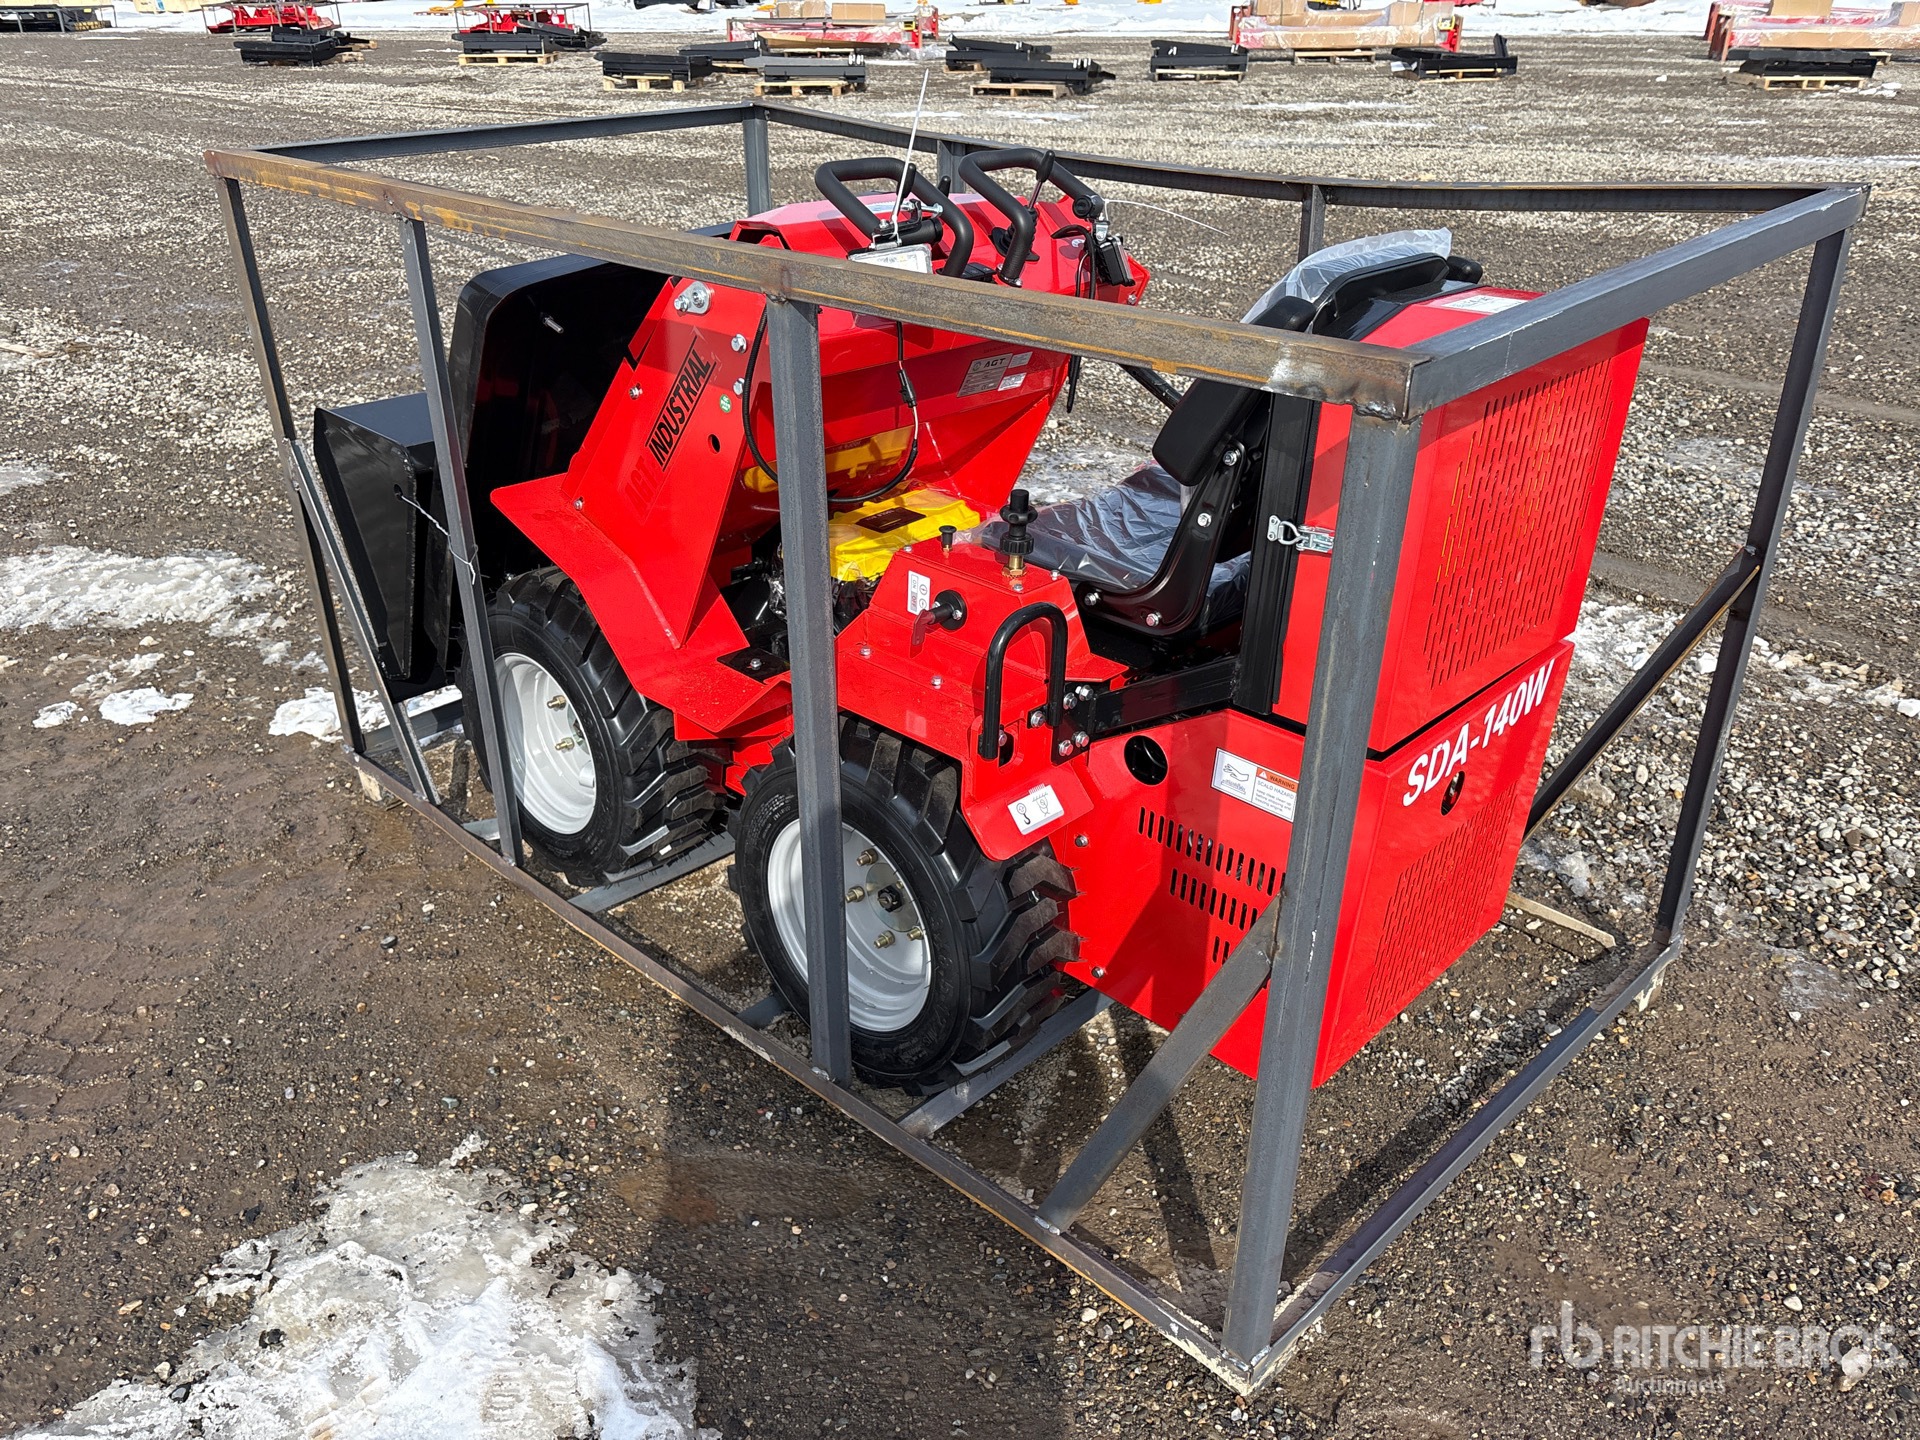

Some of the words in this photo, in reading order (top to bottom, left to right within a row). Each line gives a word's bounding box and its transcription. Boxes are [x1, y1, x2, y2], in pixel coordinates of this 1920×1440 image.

[984, 357, 1006, 368] AGT
[648, 349, 710, 467] INDUSTRIAL
[1402, 657, 1555, 807] SDA-140W
[1269, 775, 1295, 790] WARNING
[1274, 787, 1295, 800] HAZARD
